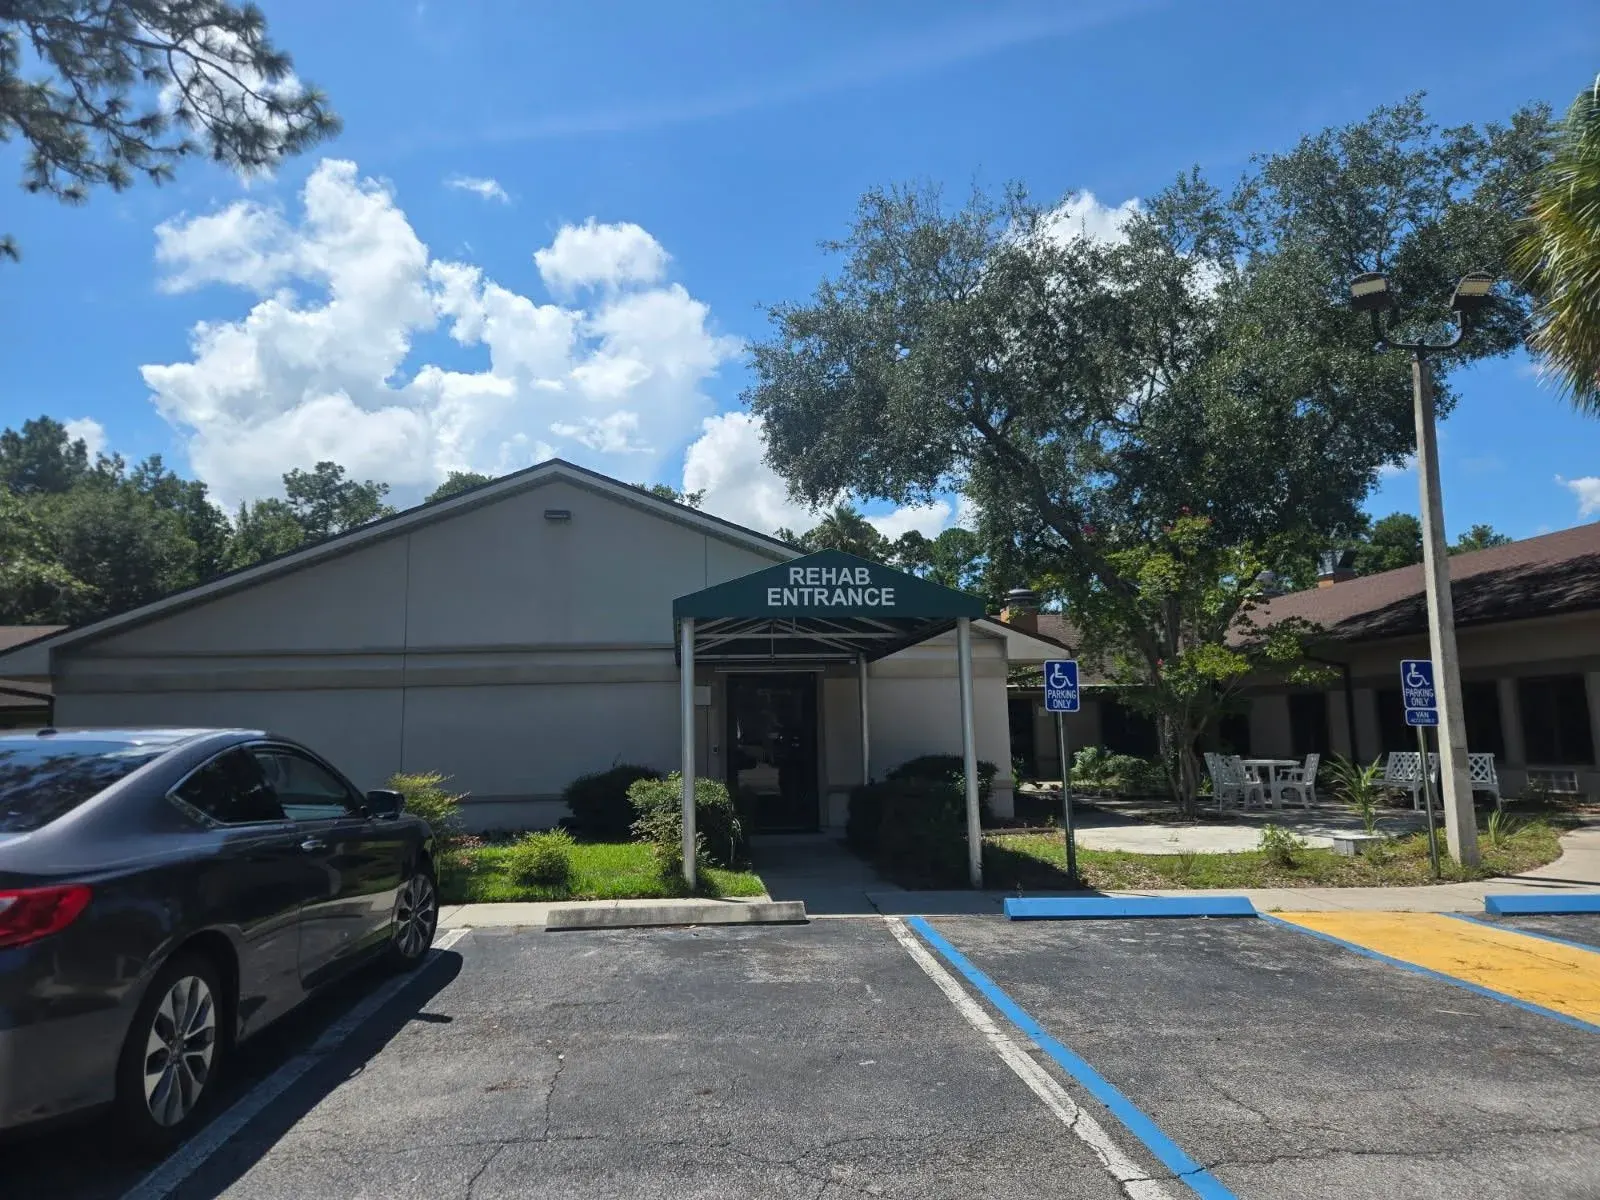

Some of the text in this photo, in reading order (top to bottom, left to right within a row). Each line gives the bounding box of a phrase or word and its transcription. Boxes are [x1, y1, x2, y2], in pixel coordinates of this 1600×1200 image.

[767, 588, 896, 607] ENTRANCE
[1047, 690, 1076, 699] PARKING
[1405, 688, 1434, 698] PARKING
[1053, 699, 1071, 708] ONLY
[1411, 697, 1430, 706] ONLY
